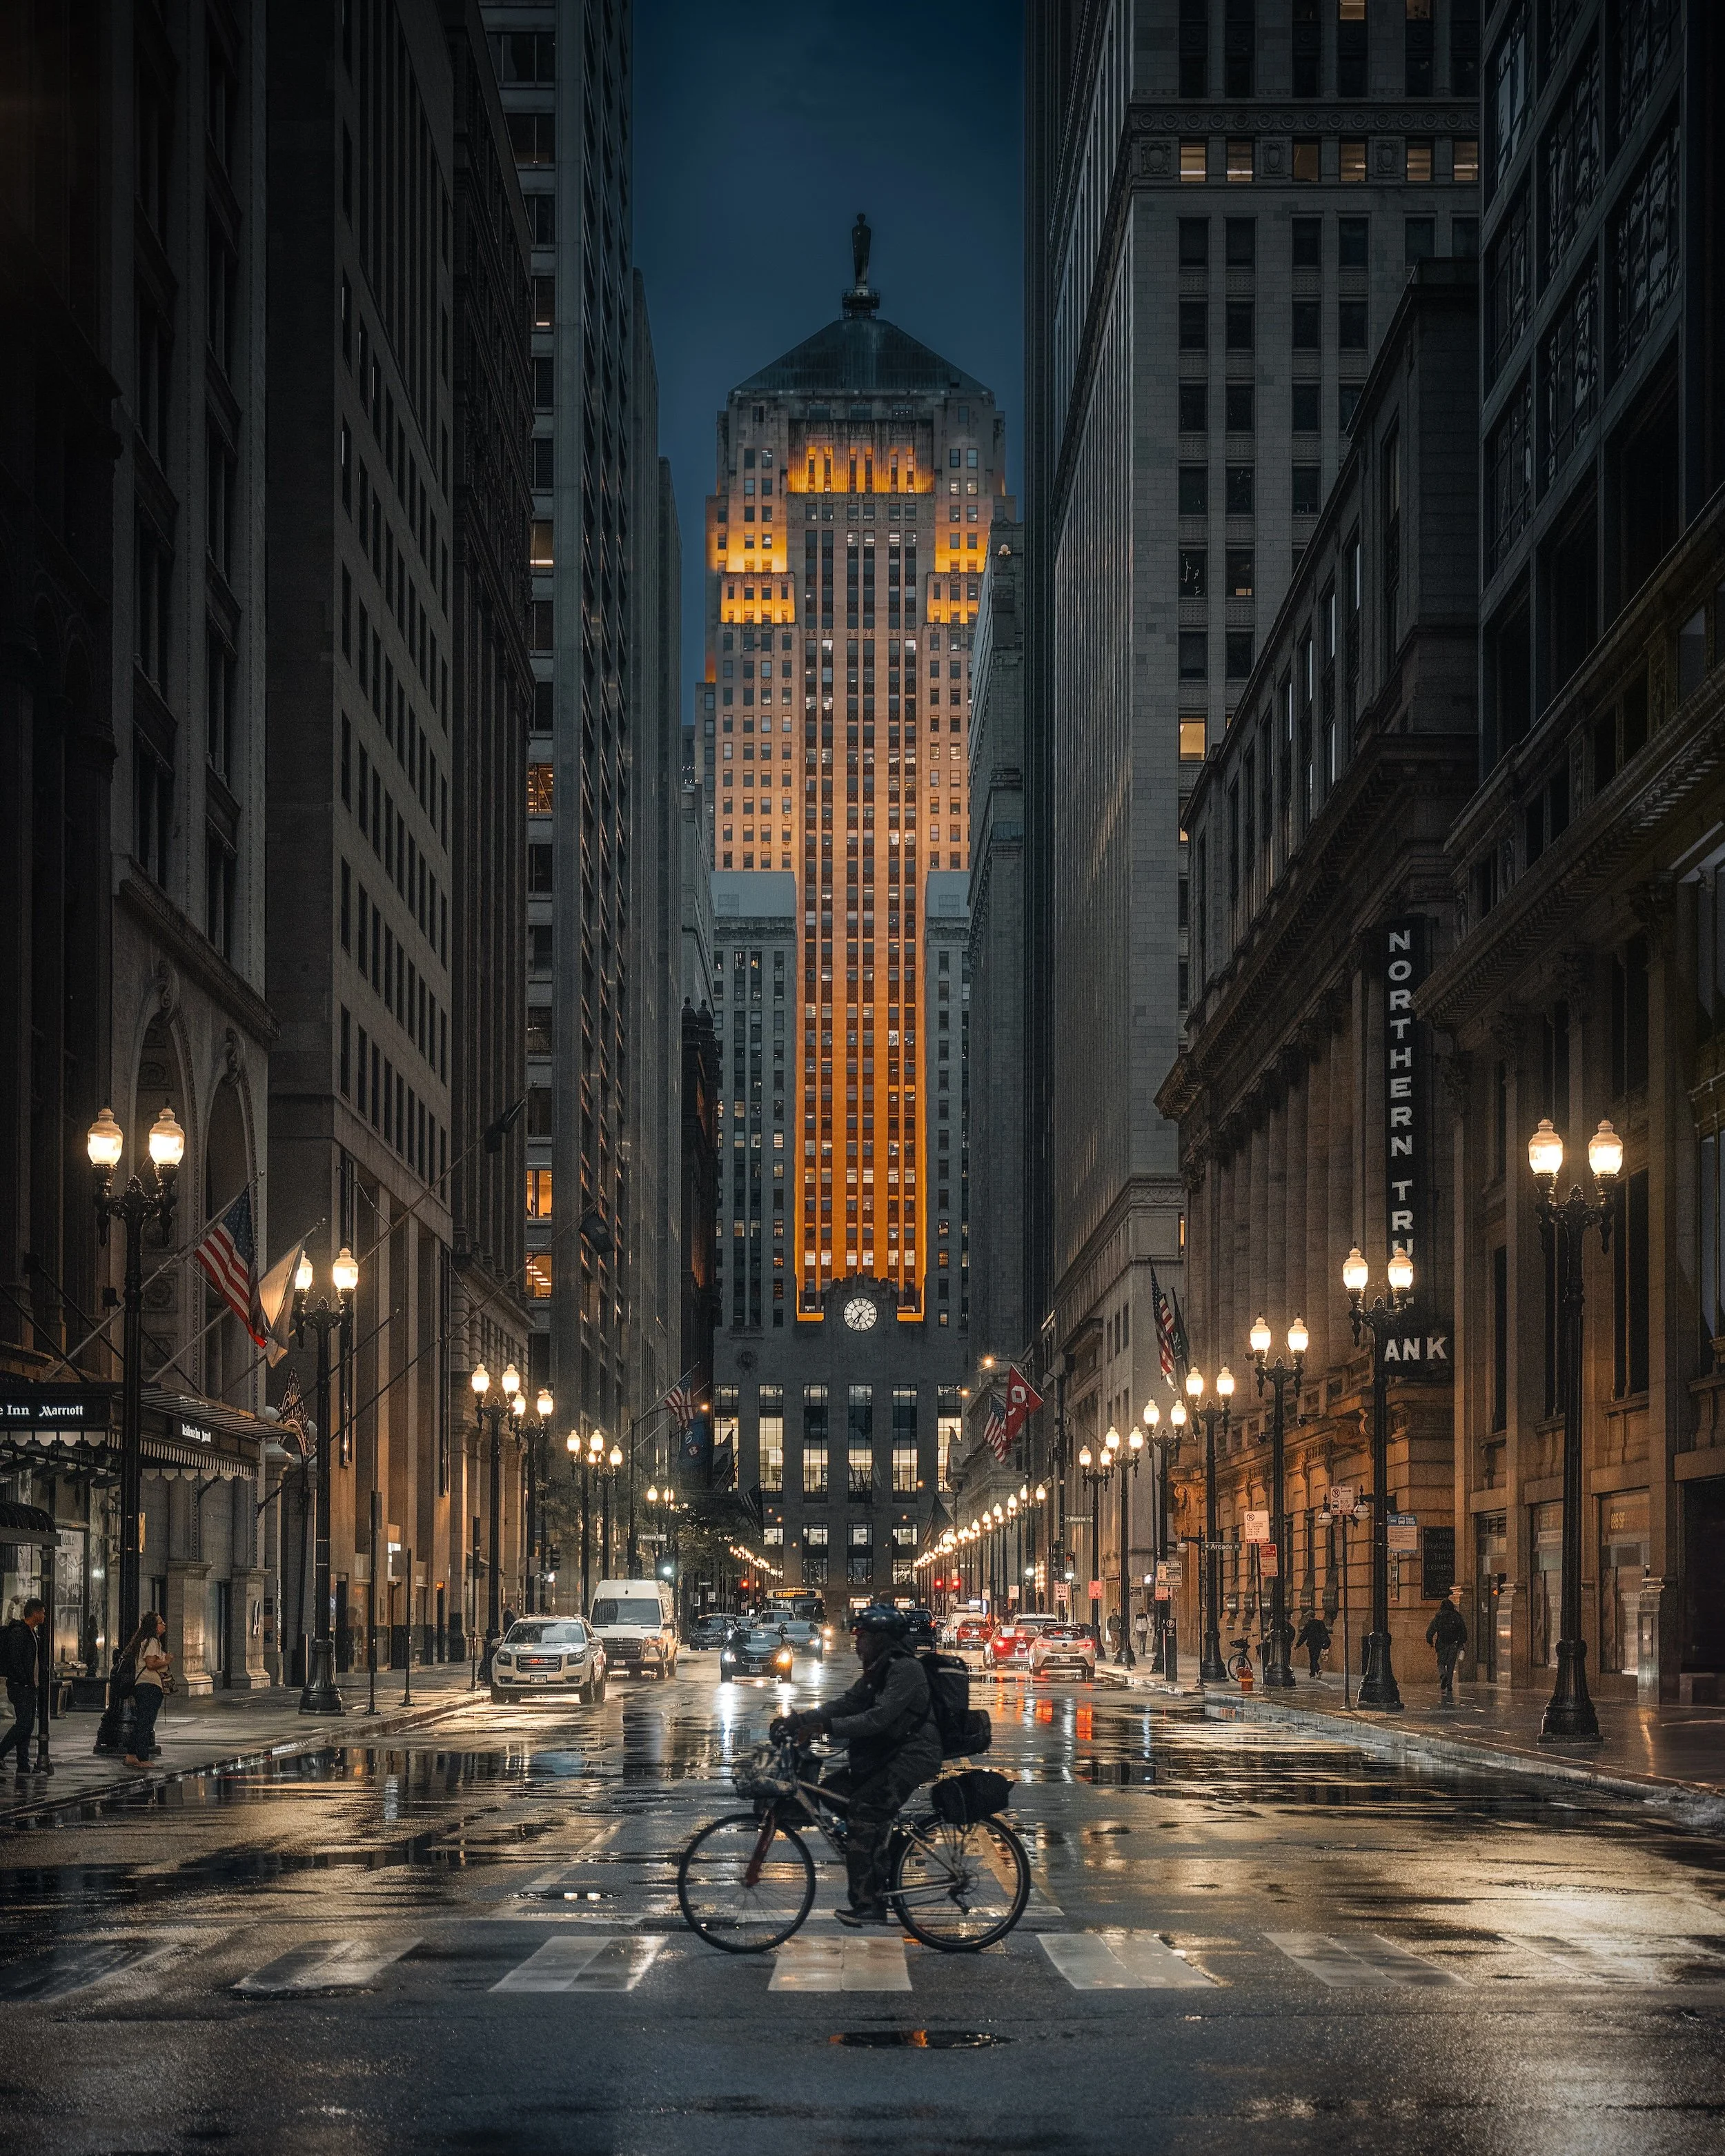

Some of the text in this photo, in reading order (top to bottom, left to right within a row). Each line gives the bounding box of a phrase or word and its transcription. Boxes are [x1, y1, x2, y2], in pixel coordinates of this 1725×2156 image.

[1388, 929, 1413, 1158] NORTHERN
[1384, 1337, 1448, 1362] ANK
[7, 1405, 30, 1415] Inn
[39, 1405, 83, 1416] Marriott
